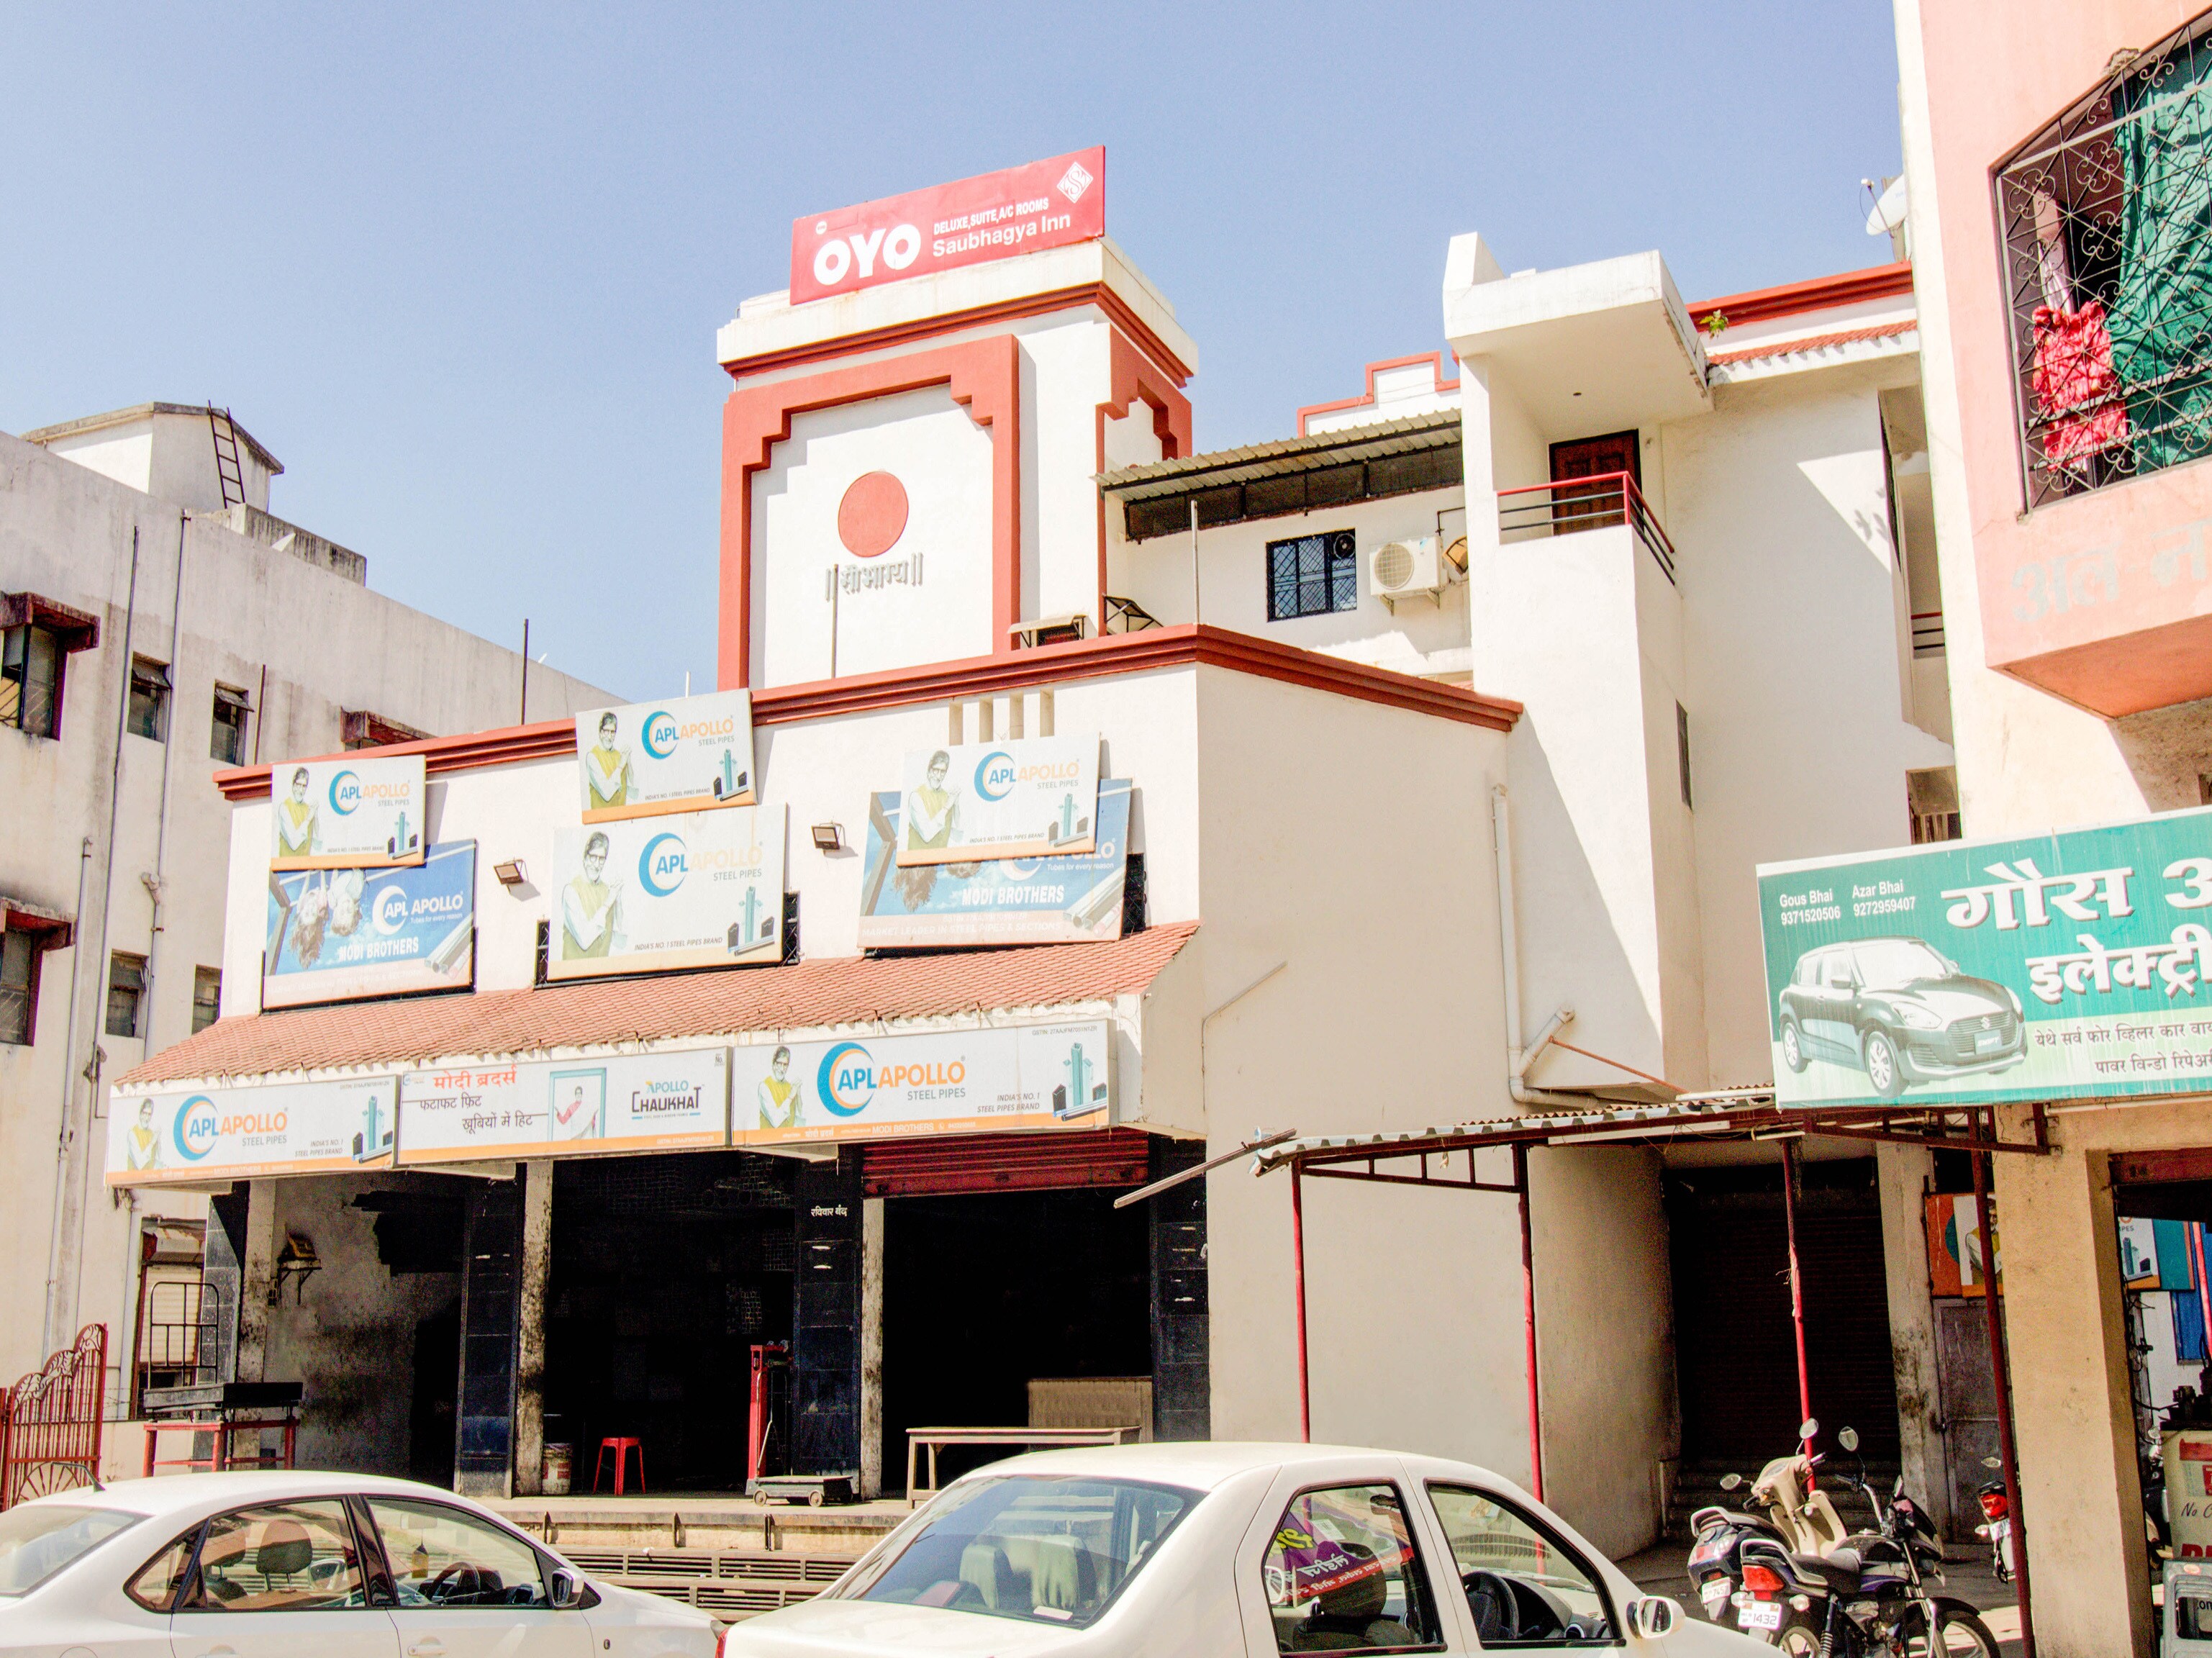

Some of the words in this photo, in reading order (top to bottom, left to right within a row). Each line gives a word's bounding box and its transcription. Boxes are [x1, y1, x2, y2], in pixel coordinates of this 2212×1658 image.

[1016, 197, 1048, 215] ROOMS
[933, 222, 1037, 257] Saubhagya
[1041, 214, 1071, 233] Inn
[813, 223, 921, 286] OYO
[655, 727, 679, 743] APL
[680, 718, 734, 739] APOLLO
[988, 768, 1016, 784] APL
[1017, 761, 1079, 781] APOLLO
[340, 786, 361, 799] APL
[363, 783, 409, 798] APOLLO
[1059, 779, 1079, 788] PIPES
[656, 854, 689, 875] APL
[691, 846, 763, 871] APOLLO
[713, 871, 737, 882] STEEL
[739, 868, 762, 879] PIPES
[961, 886, 992, 906] MODI
[997, 884, 1064, 905] BROTHERS
[1780, 893, 1808, 908] Gous
[1809, 888, 1833, 904] Bhai
[1852, 884, 1877, 899] Azar
[1879, 879, 1905, 895] Bhai
[1940, 858, 2135, 930] गौस
[384, 902, 408, 919] APL
[411, 894, 463, 915] APOLLO
[1780, 905, 1841, 926] 9371520506
[1853, 896, 1916, 917] 9272959407
[338, 944, 364, 962] MODI
[367, 937, 419, 959] BROTHERS
[635, 943, 654, 951] INDIA'S
[2035, 1029, 2057, 1046] येथे
[2061, 1026, 2082, 1046] सर्व
[2087, 1025, 2111, 1043] फोर
[2159, 1023, 2185, 1038] कार
[837, 1067, 877, 1091] APL
[878, 1061, 966, 1089] APOLLO
[2095, 1059, 2126, 1074] पावर
[433, 1070, 471, 1090] मोदी
[476, 1064, 517, 1088] ब्रदर्स
[645, 1079, 689, 1093] APOLLO
[420, 1097, 458, 1110] फटाफट
[632, 1087, 702, 1113] CHAUKHAT
[907, 1090, 935, 1101] STEEL
[938, 1087, 966, 1099] PIPES
[997, 1093, 1020, 1102] INDIA'S
[189, 1118, 219, 1138] APL
[220, 1112, 288, 1136] APOLLO
[515, 1110, 533, 1128] हिट
[872, 1125, 892, 1135] MODI
[894, 1122, 934, 1133] BROTHERS
[242, 1136, 264, 1146] STEEL
[266, 1135, 287, 1145] PIPES
[811, 1205, 833, 1217] रविवार
[835, 1204, 848, 1217] बंद
[1753, 1613, 1777, 1626] 1432
